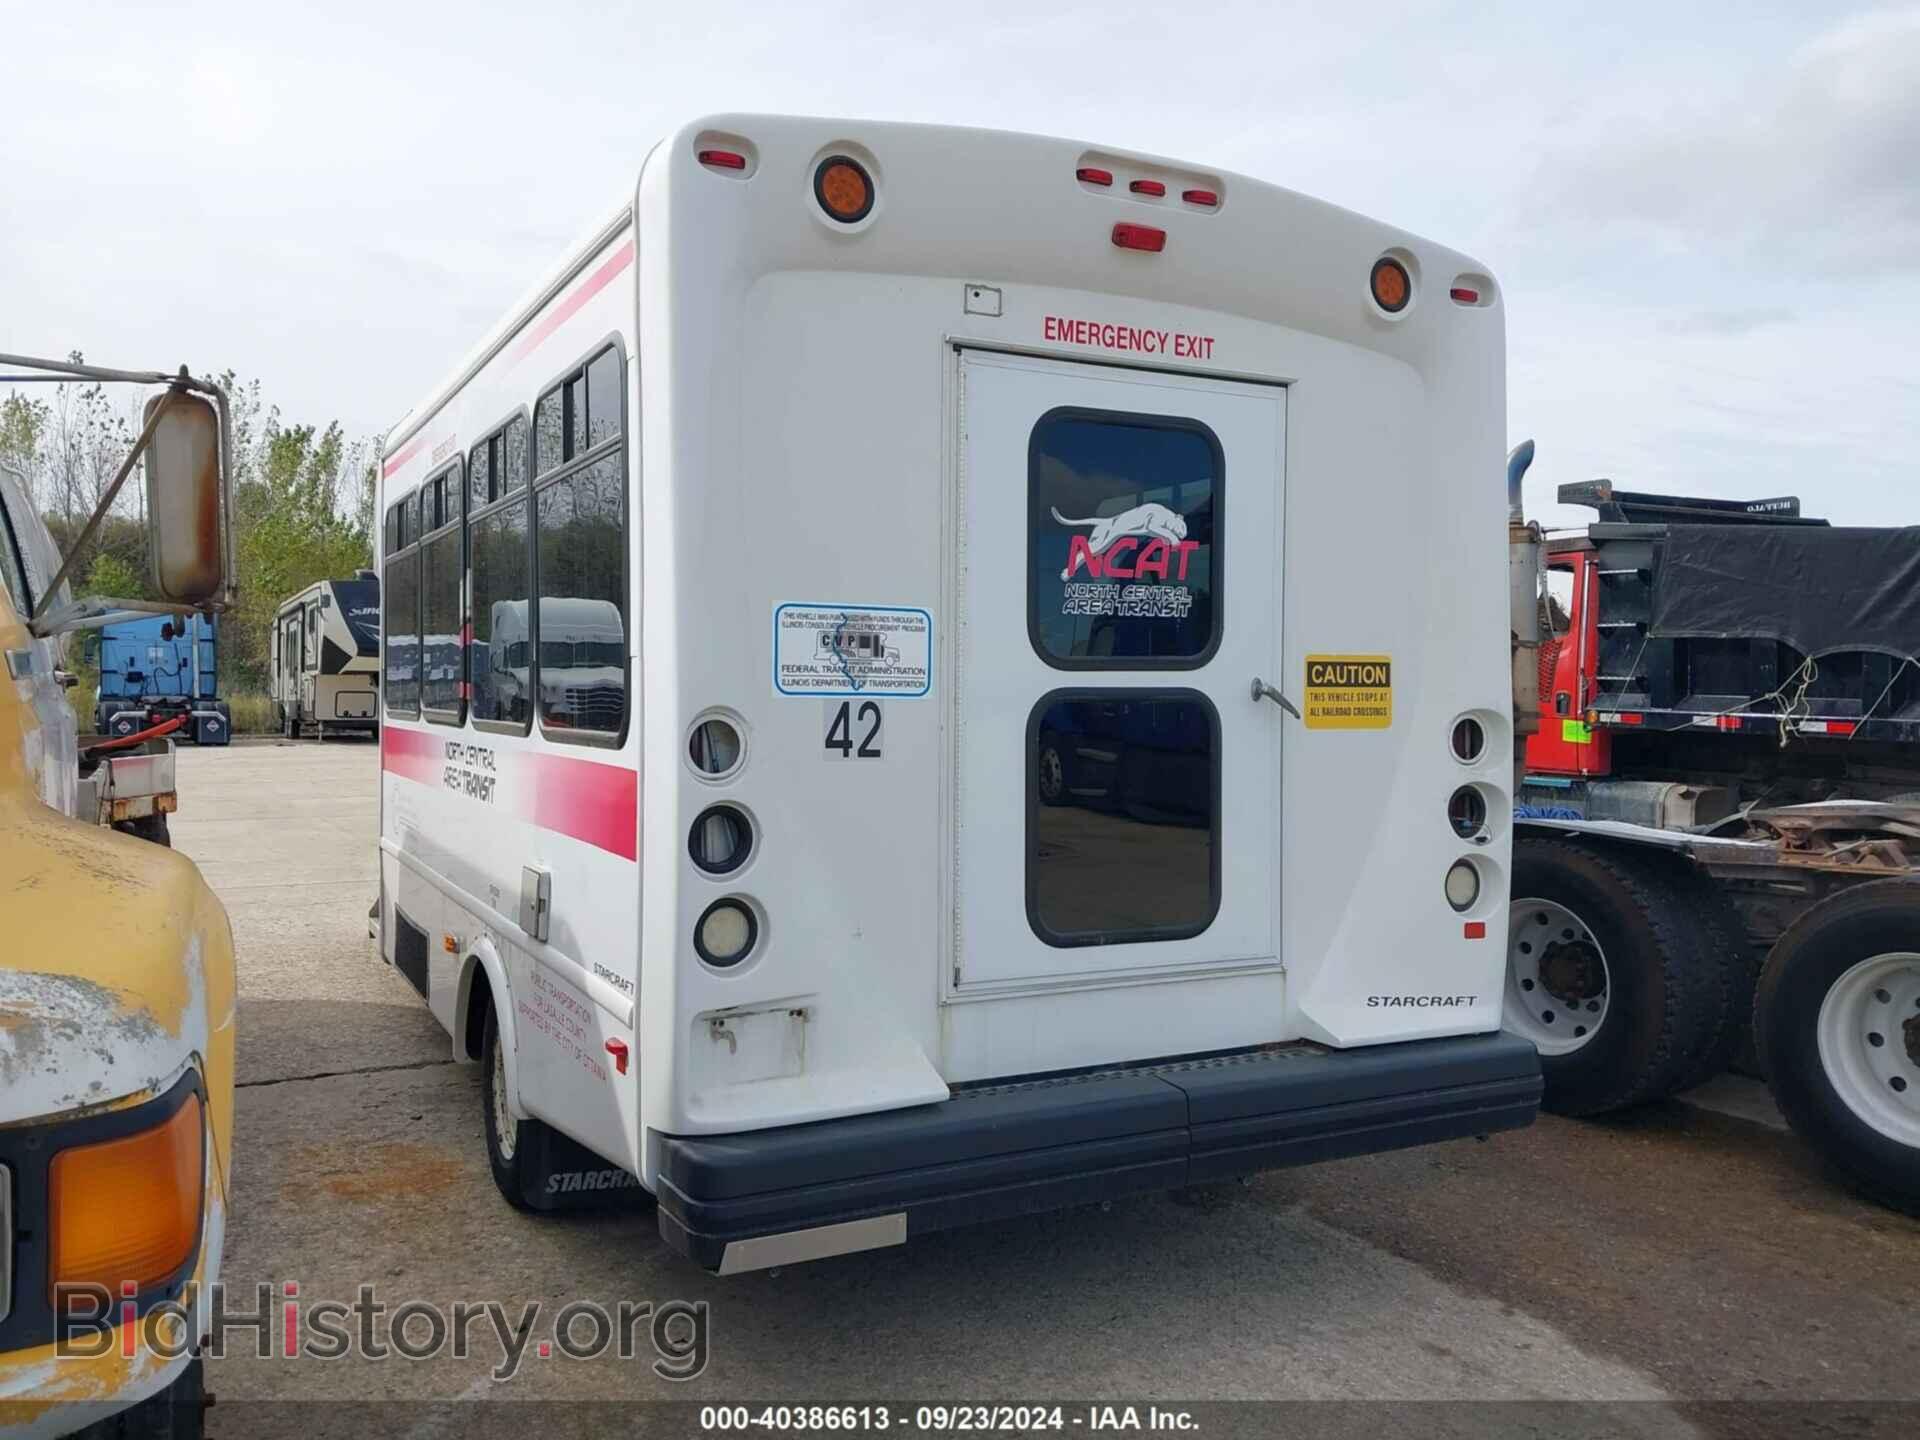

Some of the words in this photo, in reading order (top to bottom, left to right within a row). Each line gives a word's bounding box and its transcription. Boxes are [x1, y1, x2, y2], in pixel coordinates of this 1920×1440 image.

[1044, 316, 1169, 354] EMERGENCY
[1174, 334, 1215, 360] EXIT
[1067, 535, 1200, 581] NCAT
[1064, 583, 1121, 600] NORTH
[1122, 584, 1193, 601] CENTRAL
[1062, 599, 1117, 616] AREA
[1116, 601, 1192, 618] TRANSIT
[781, 664, 819, 674] FEDERAL
[857, 665, 926, 676] ADMINISTRATION
[1311, 665, 1386, 684] CAUTION
[781, 678, 810, 688] ILLINOIS
[869, 680, 926, 689] TRANSPORTATION
[1310, 692, 1325, 702] THIS
[825, 700, 882, 758] 42
[465, 745, 496, 771] CENTRAL
[462, 770, 496, 804] TRANSIT
[593, 962, 635, 995] STARCRAFT
[1366, 995, 1478, 1008] STARCRAFT
